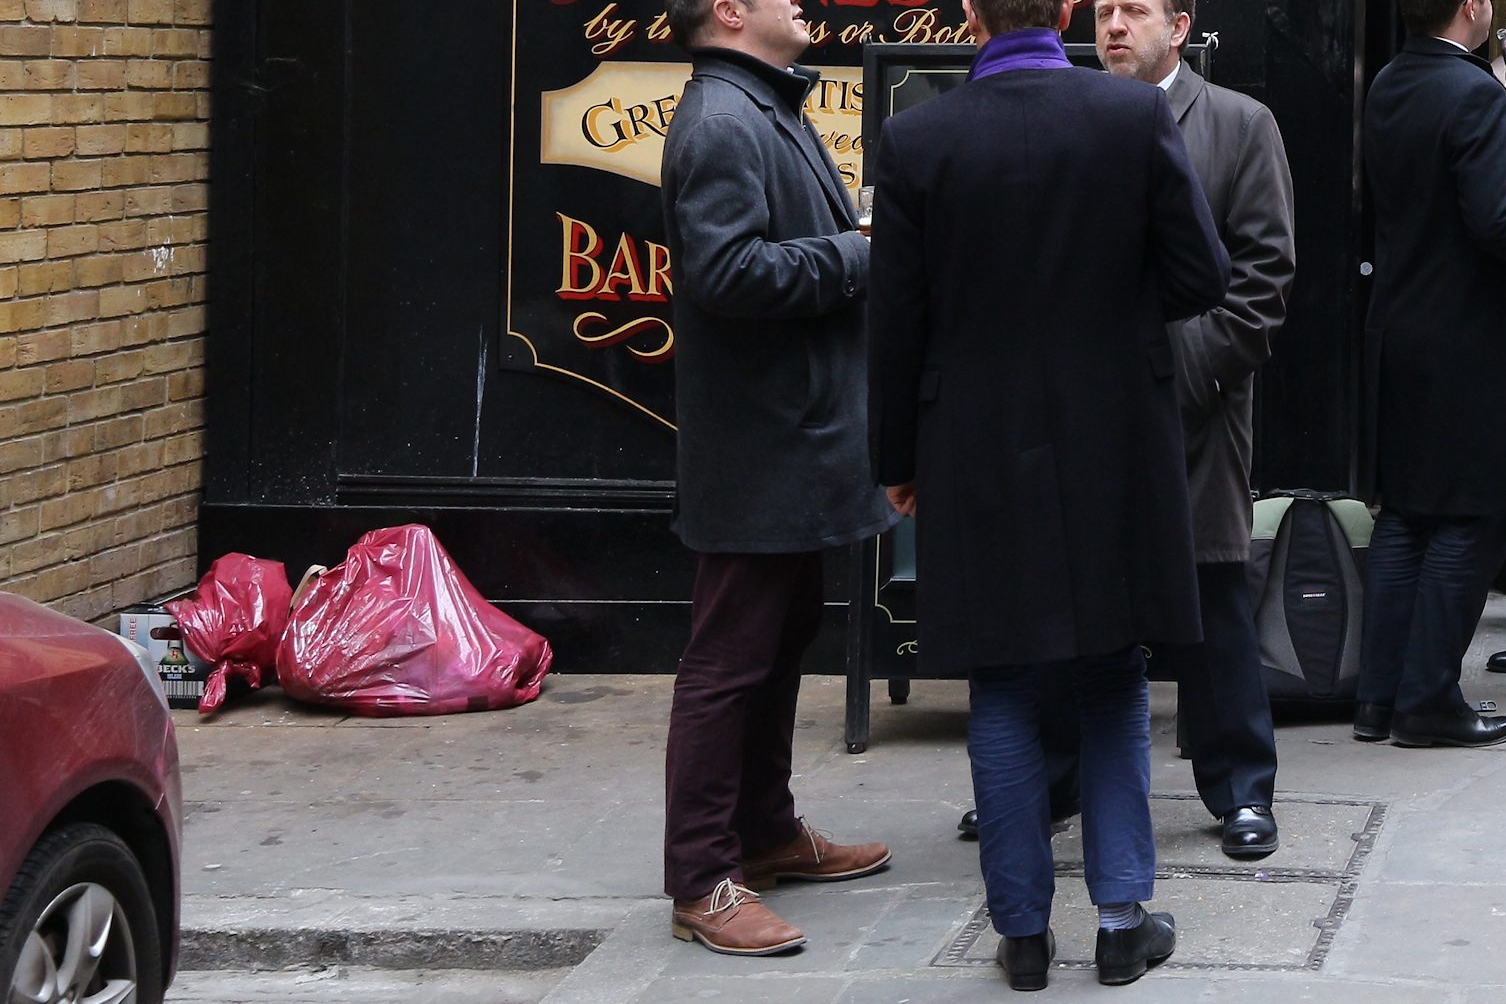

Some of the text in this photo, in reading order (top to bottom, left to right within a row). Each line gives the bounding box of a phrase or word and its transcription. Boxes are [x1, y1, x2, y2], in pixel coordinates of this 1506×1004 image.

[583, 2, 638, 55] by
[877, 7, 977, 44] Bot
[581, 94, 676, 149] GRE
[156, 664, 195, 674] BECK'S
